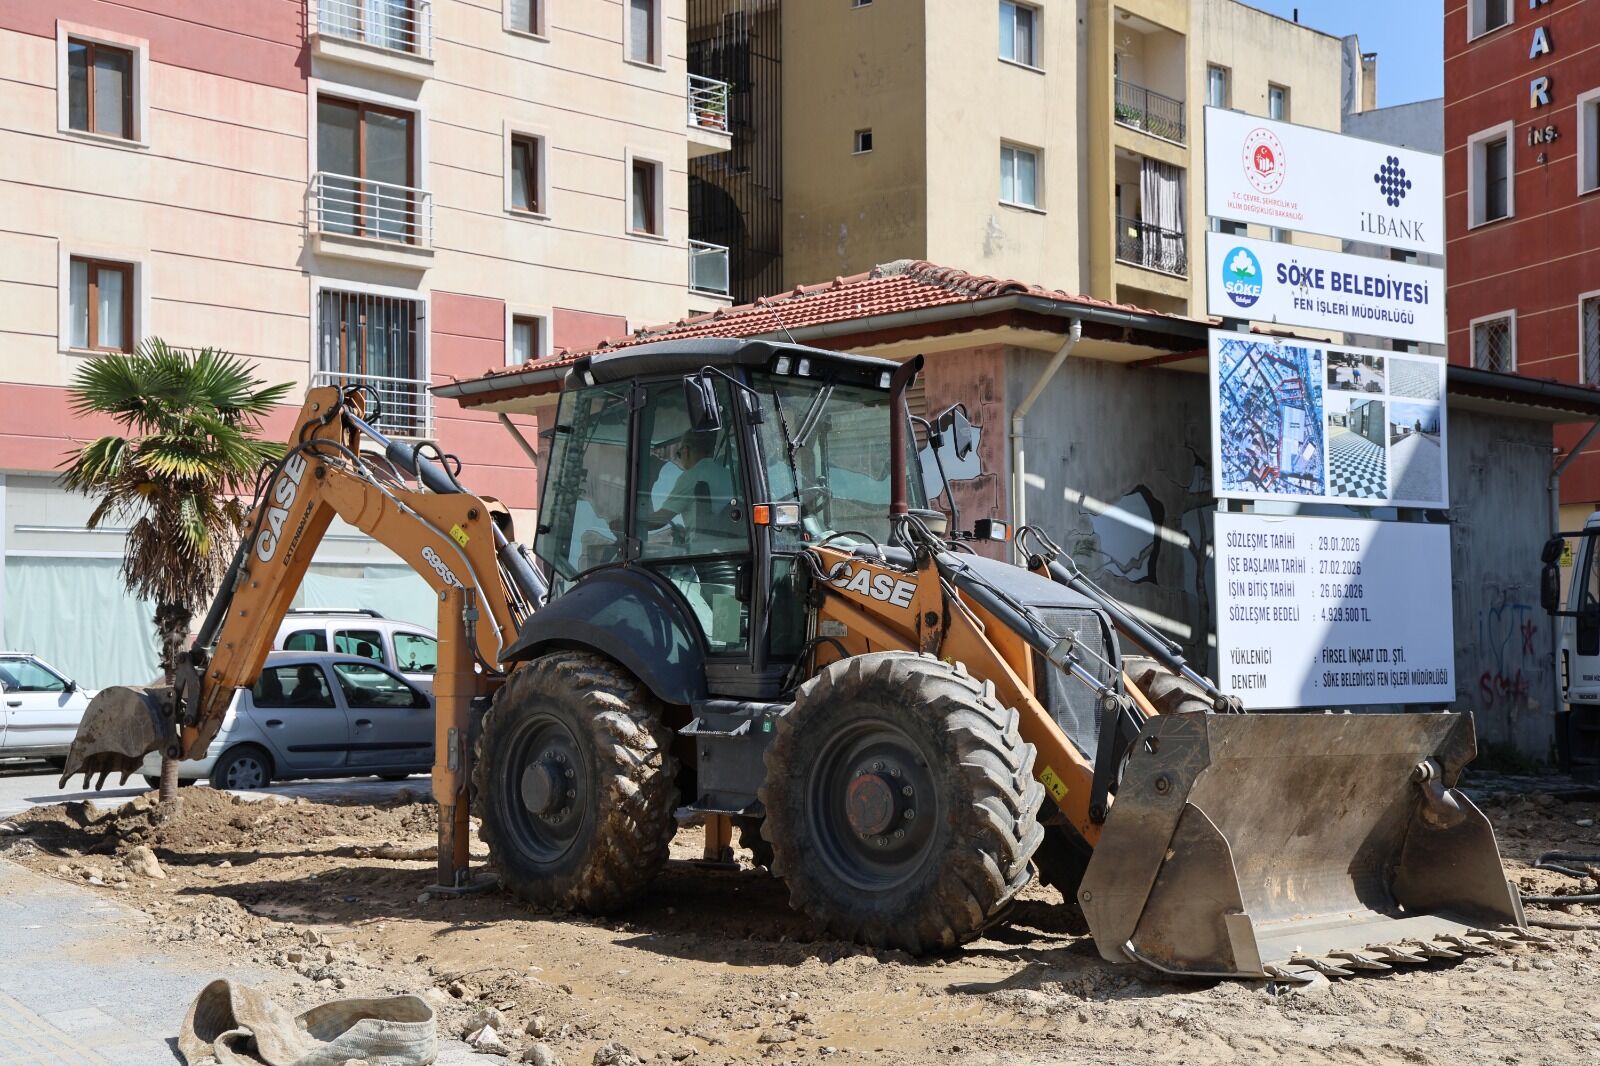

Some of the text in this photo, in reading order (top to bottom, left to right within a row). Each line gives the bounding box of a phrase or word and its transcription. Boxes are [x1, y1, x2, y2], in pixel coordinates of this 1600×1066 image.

[1291, 202, 1298, 210] VE
[1225, 279, 1262, 297] SÖKE
[1276, 259, 1429, 305] SÖKE BELEDİYESİ
[1293, 297, 1414, 325] FEN İŞLERİ MÜDÜRLÜĞÜ
[256, 453, 308, 563] CASE
[1226, 530, 1268, 551] SÖZLEŞME
[1270, 532, 1295, 550] TARİHİ
[1318, 536, 1360, 552] 29.01.2026
[1227, 554, 1241, 575] İŞE
[1243, 557, 1280, 576] BAŞLAMA
[1281, 556, 1306, 574] TARİHİ
[1319, 560, 1362, 576] 27.02.2026
[829, 561, 918, 609] CASE
[1228, 579, 1245, 600] İŞİN
[1248, 579, 1268, 600] BİTİŞ
[1270, 579, 1295, 598] TARİHİ
[1320, 583, 1364, 599] 26.06.2026
[1229, 603, 1271, 625] SÖZLEŞME
[1273, 604, 1300, 622] BEDELİ
[1321, 607, 1359, 622] 4.929.500
[1360, 607, 1372, 622] TL.
[1230, 647, 1272, 665] YÜKLENİCİ
[1322, 646, 1347, 664] FİRSEL
[1348, 646, 1374, 666] İNŞAAT
[1376, 648, 1391, 663] LTD.
[1392, 646, 1407, 666] ŞTİ.
[1231, 672, 1267, 690] DENETİM
[1322, 670, 1340, 688] SÖKE
[1341, 669, 1376, 687] BELEDİYESİ
[1377, 671, 1389, 687] FEN
[1390, 668, 1410, 689] İŞLERİ
[1411, 668, 1448, 685] MÜDÜRLÜĞÜ
